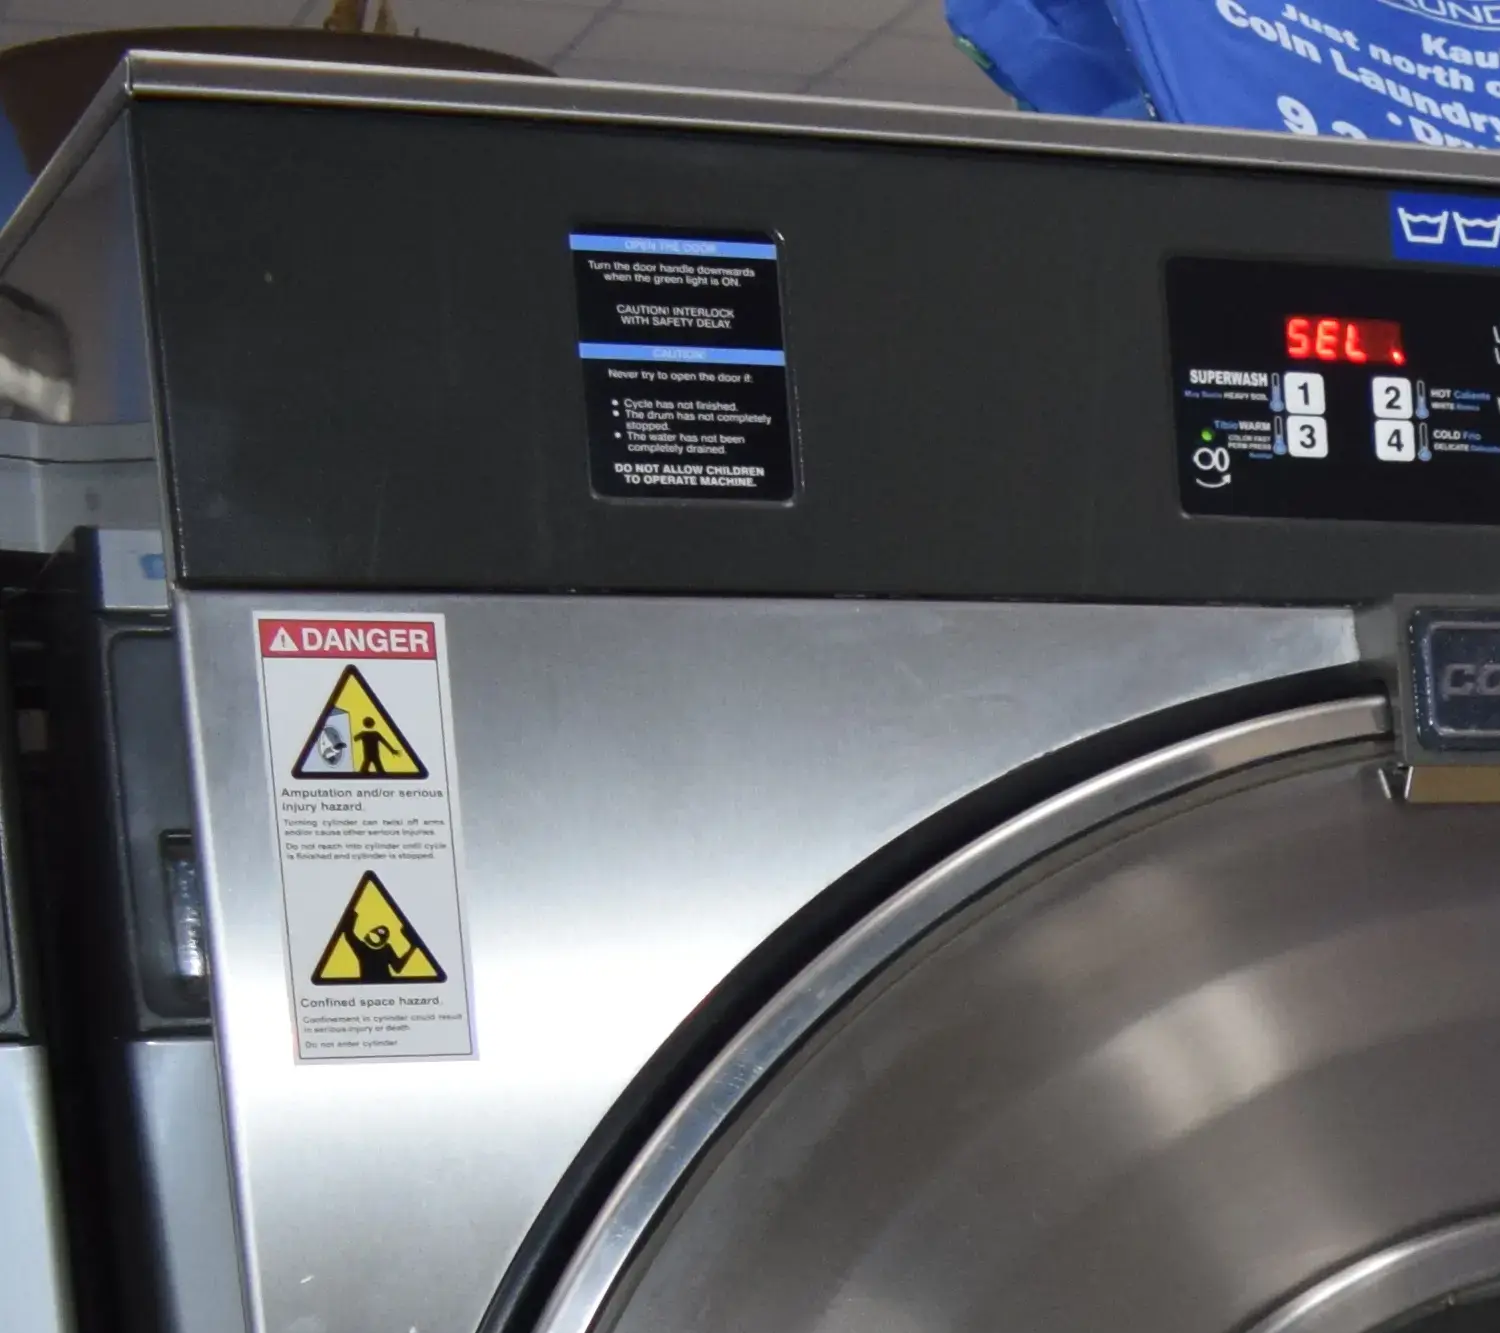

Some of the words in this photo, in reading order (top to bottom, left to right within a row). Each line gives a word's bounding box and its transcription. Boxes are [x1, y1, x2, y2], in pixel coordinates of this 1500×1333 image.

[1215, 0, 1321, 64] Coin
[1281, 3, 1361, 51] Just
[1369, 43, 1475, 93] north
[588, 260, 611, 270] Turn
[614, 262, 630, 271] the
[633, 263, 656, 272] door
[660, 264, 694, 274] handle
[697, 266, 755, 277] downwards
[604, 273, 632, 282] when
[635, 273, 650, 282] the
[654, 275, 683, 285] green
[686, 276, 708, 286] light
[711, 277, 719, 285] is
[722, 278, 741, 287] ON.
[617, 304, 669, 315] CAUTION!
[673, 307, 735, 318] INTERLOCK
[622, 316, 649, 325] WITH
[653, 317, 694, 327] SAFETY
[697, 318, 732, 329] DELAY.
[608, 368, 638, 378] Never
[642, 370, 654, 381] try
[658, 371, 668, 379] to
[671, 372, 696, 382] open
[699, 372, 715, 382] the
[718, 373, 740, 382] door
[1190, 369, 1268, 386] SUPERWASH
[1298, 382, 1310, 405] 1
[1385, 386, 1402, 409] 2
[1430, 389, 1451, 398] HOT
[624, 399, 653, 410] Cycle
[656, 400, 674, 409] has
[678, 401, 694, 410] not
[696, 401, 738, 411] finished.
[626, 409, 644, 419] The
[647, 410, 674, 420] drum
[677, 412, 695, 420] has
[700, 412, 715, 421] not
[717, 413, 772, 425] completely
[626, 421, 672, 432] stopped.
[1239, 421, 1271, 431] WARM
[627, 432, 646, 441] The
[649, 433, 676, 442] water
[680, 434, 698, 443] has
[701, 434, 717, 443] not
[720, 434, 745, 443] been
[1300, 424, 1316, 448] 3
[1388, 430, 1404, 452] 4
[1433, 430, 1461, 439] COLD
[628, 443, 684, 454] completely
[687, 444, 727, 454] drained.
[1434, 443, 1469, 452] DELICATE
[615, 463, 632, 473] DO
[635, 464, 659, 473] NOT
[663, 465, 703, 474] ALLOW
[707, 466, 764, 477] CHILDREN
[624, 474, 640, 484] TO
[644, 476, 697, 485] OPERATE
[700, 476, 757, 487] MACHINE.
[302, 627, 429, 654] DANGER
[282, 788, 352, 798] Amputation
[357, 789, 395, 797] and/or
[301, 997, 355, 1008] Confined
[360, 999, 395, 1008] space
